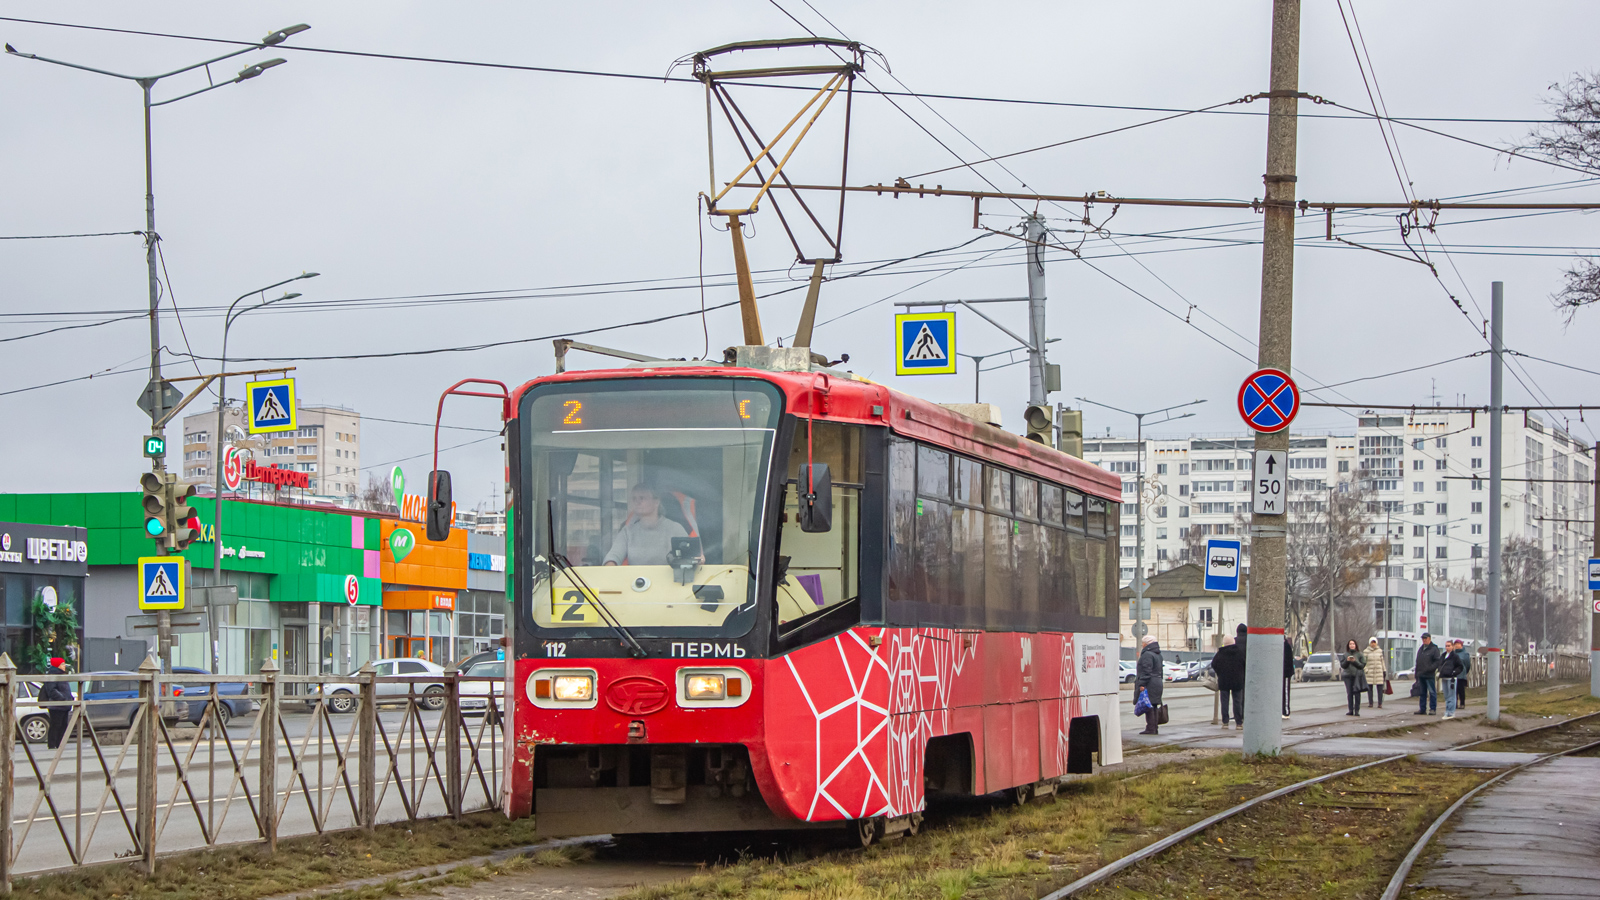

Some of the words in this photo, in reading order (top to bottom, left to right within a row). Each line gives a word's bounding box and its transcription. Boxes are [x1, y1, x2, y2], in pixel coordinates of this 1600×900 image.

[563, 400, 582, 424] 2
[148, 441, 163, 453] 04
[1259, 479, 1281, 495] 50
[26, 537, 77, 564] ЦВЕТЫ
[561, 590, 585, 621] 2
[545, 643, 567, 658] 112
[670, 642, 747, 658] ПЕРМЬ
